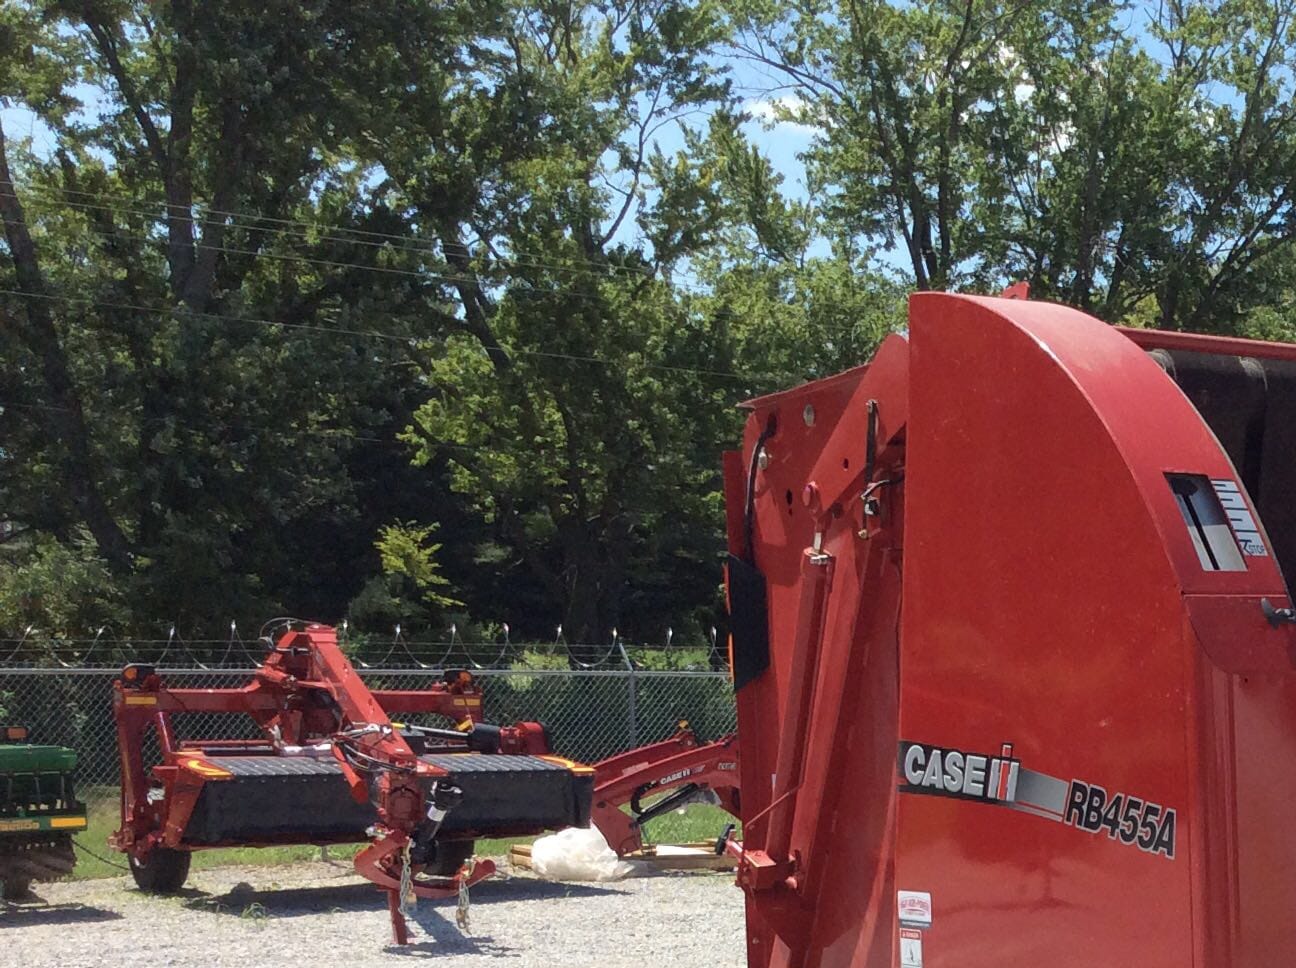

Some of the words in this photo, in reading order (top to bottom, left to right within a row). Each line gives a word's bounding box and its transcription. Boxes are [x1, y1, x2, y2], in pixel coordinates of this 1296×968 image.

[660, 771, 683, 785] CASE
[903, 744, 988, 797] CASE
[1063, 778, 1178, 861] RB455A
